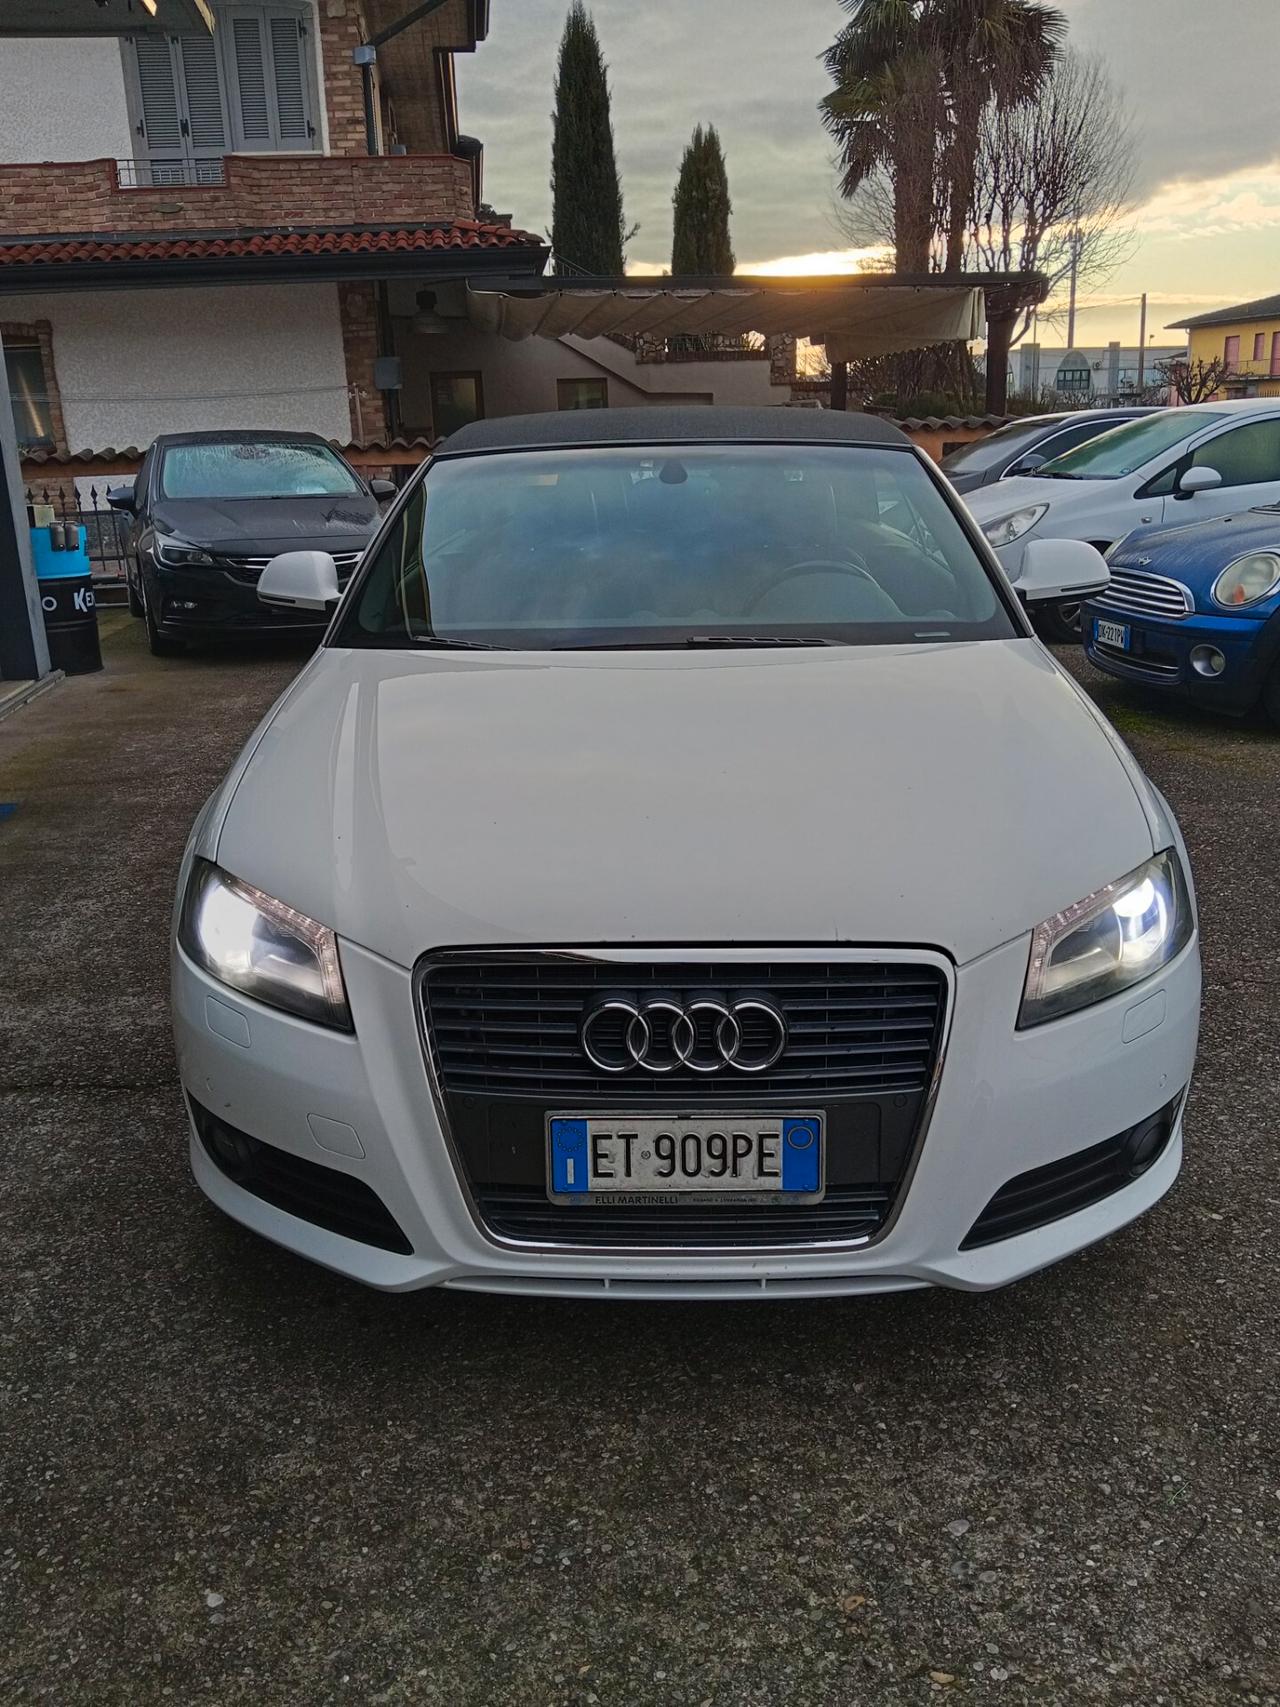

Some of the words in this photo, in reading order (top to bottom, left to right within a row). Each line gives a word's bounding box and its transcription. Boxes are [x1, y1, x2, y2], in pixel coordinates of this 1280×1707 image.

[591, 1133, 638, 1178] ET
[654, 1132, 780, 1178] 909PE
[616, 1195, 679, 1205] MARTINELLI
